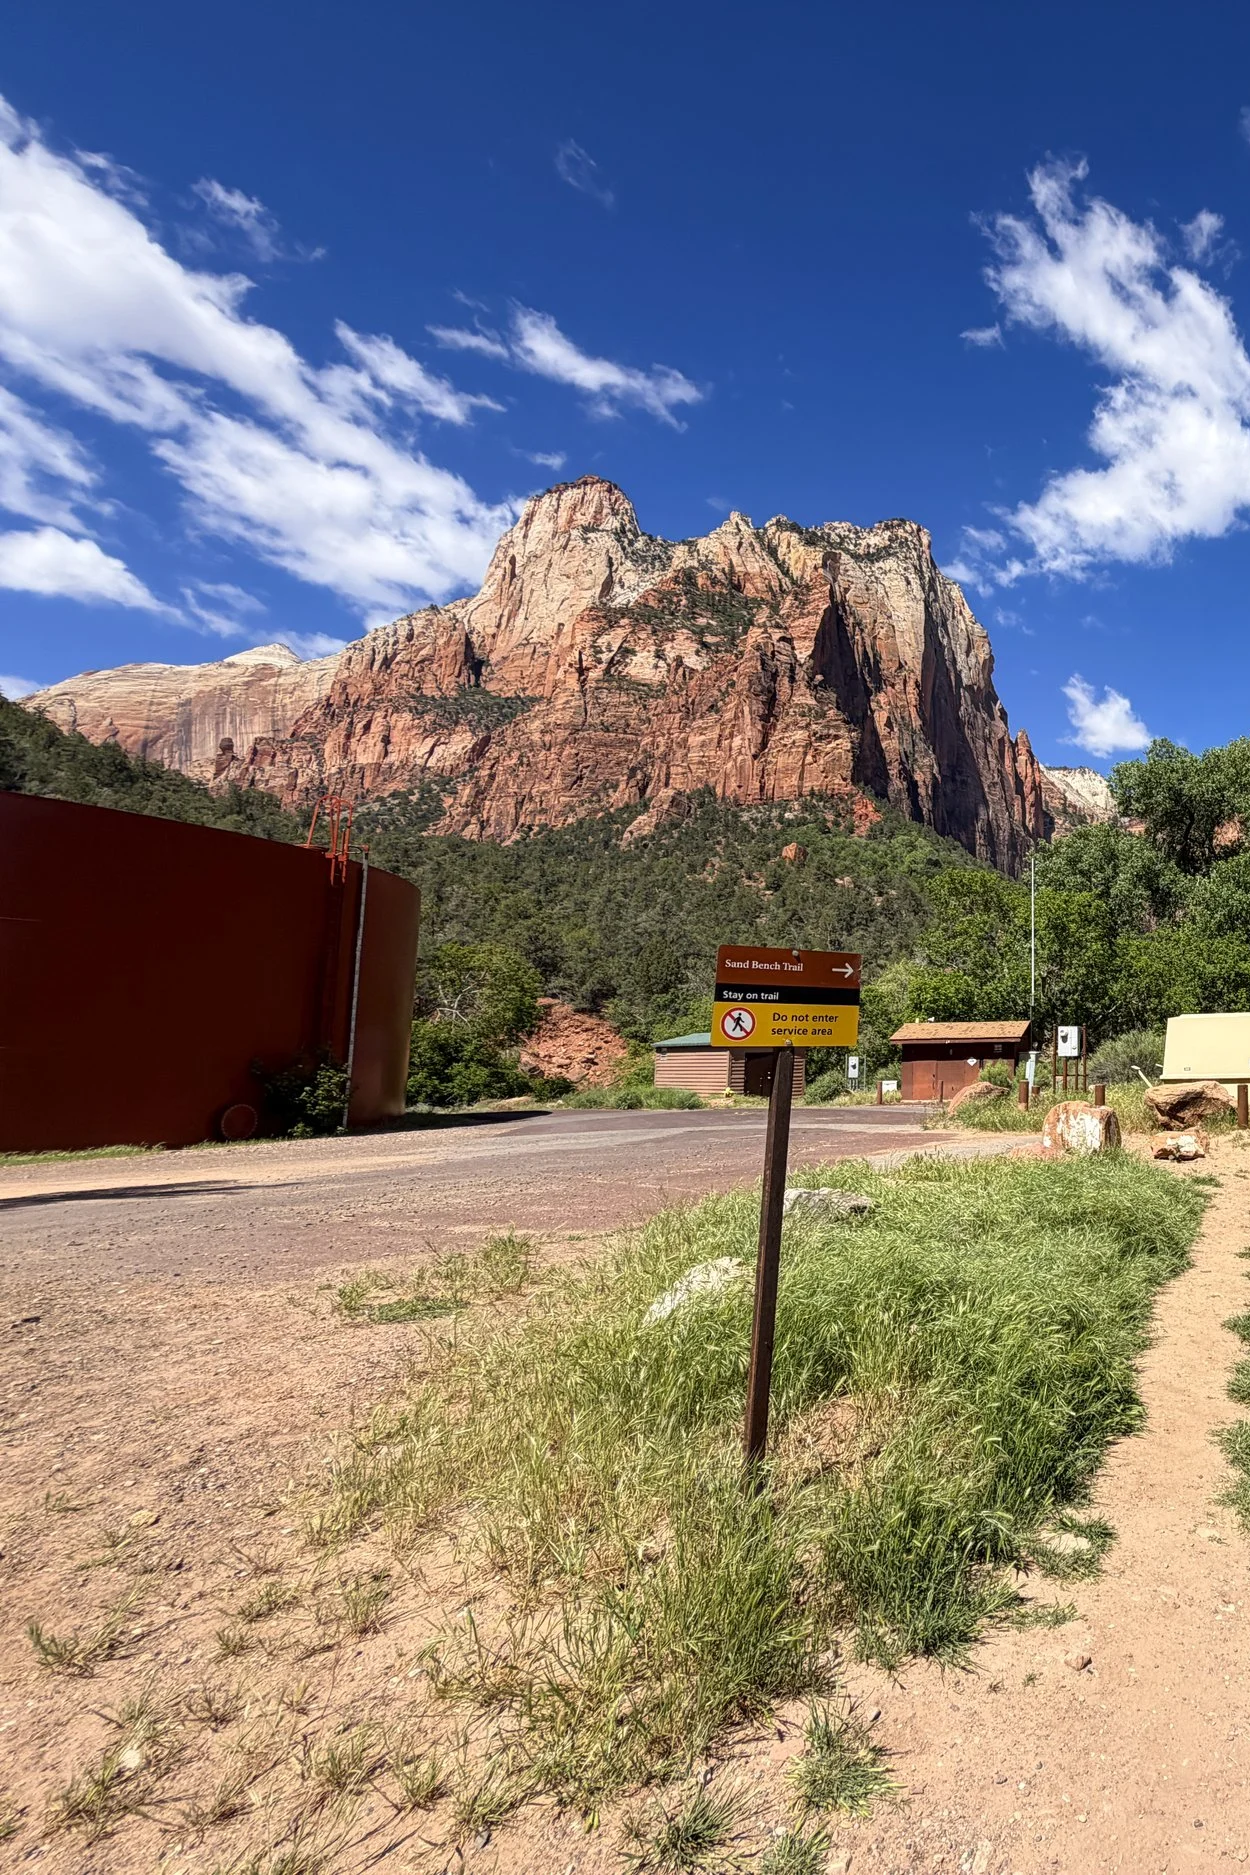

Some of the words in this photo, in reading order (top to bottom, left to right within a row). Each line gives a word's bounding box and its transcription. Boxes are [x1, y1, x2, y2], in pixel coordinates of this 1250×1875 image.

[724, 959, 750, 969] Sand
[752, 960, 780, 970] Bench
[782, 962, 804, 972] Trail
[722, 990, 744, 1000] Stay
[760, 992, 779, 1000] trail
[772, 1012, 788, 1022] Do
[791, 1014, 808, 1022] not
[771, 1026, 808, 1035] service
